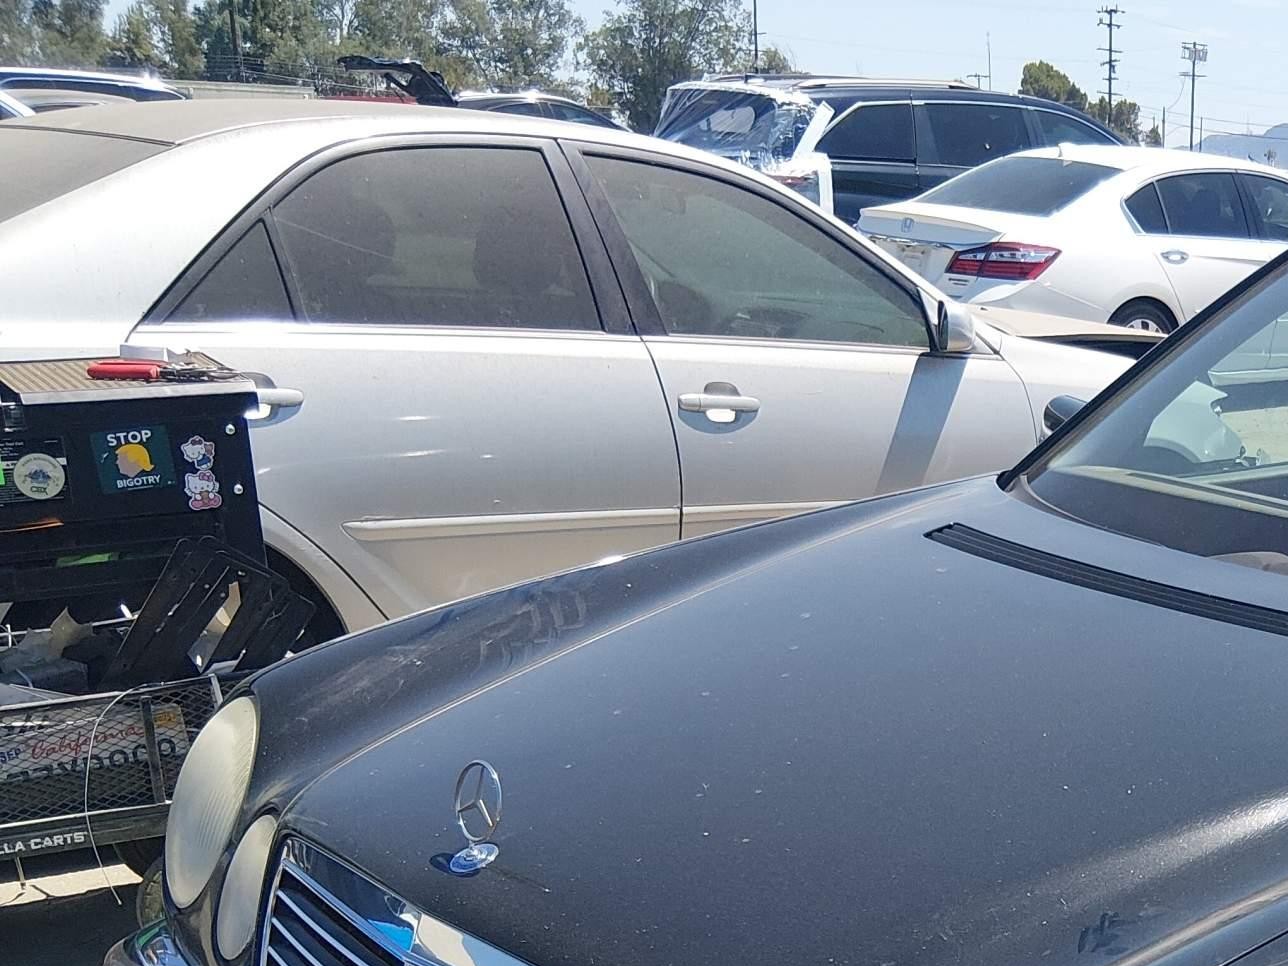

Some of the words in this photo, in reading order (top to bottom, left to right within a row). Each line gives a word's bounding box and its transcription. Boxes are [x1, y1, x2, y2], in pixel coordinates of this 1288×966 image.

[106, 430, 152, 446] STOP
[116, 475, 161, 488] BIGOTRY
[30, 832, 85, 850] CARTS
